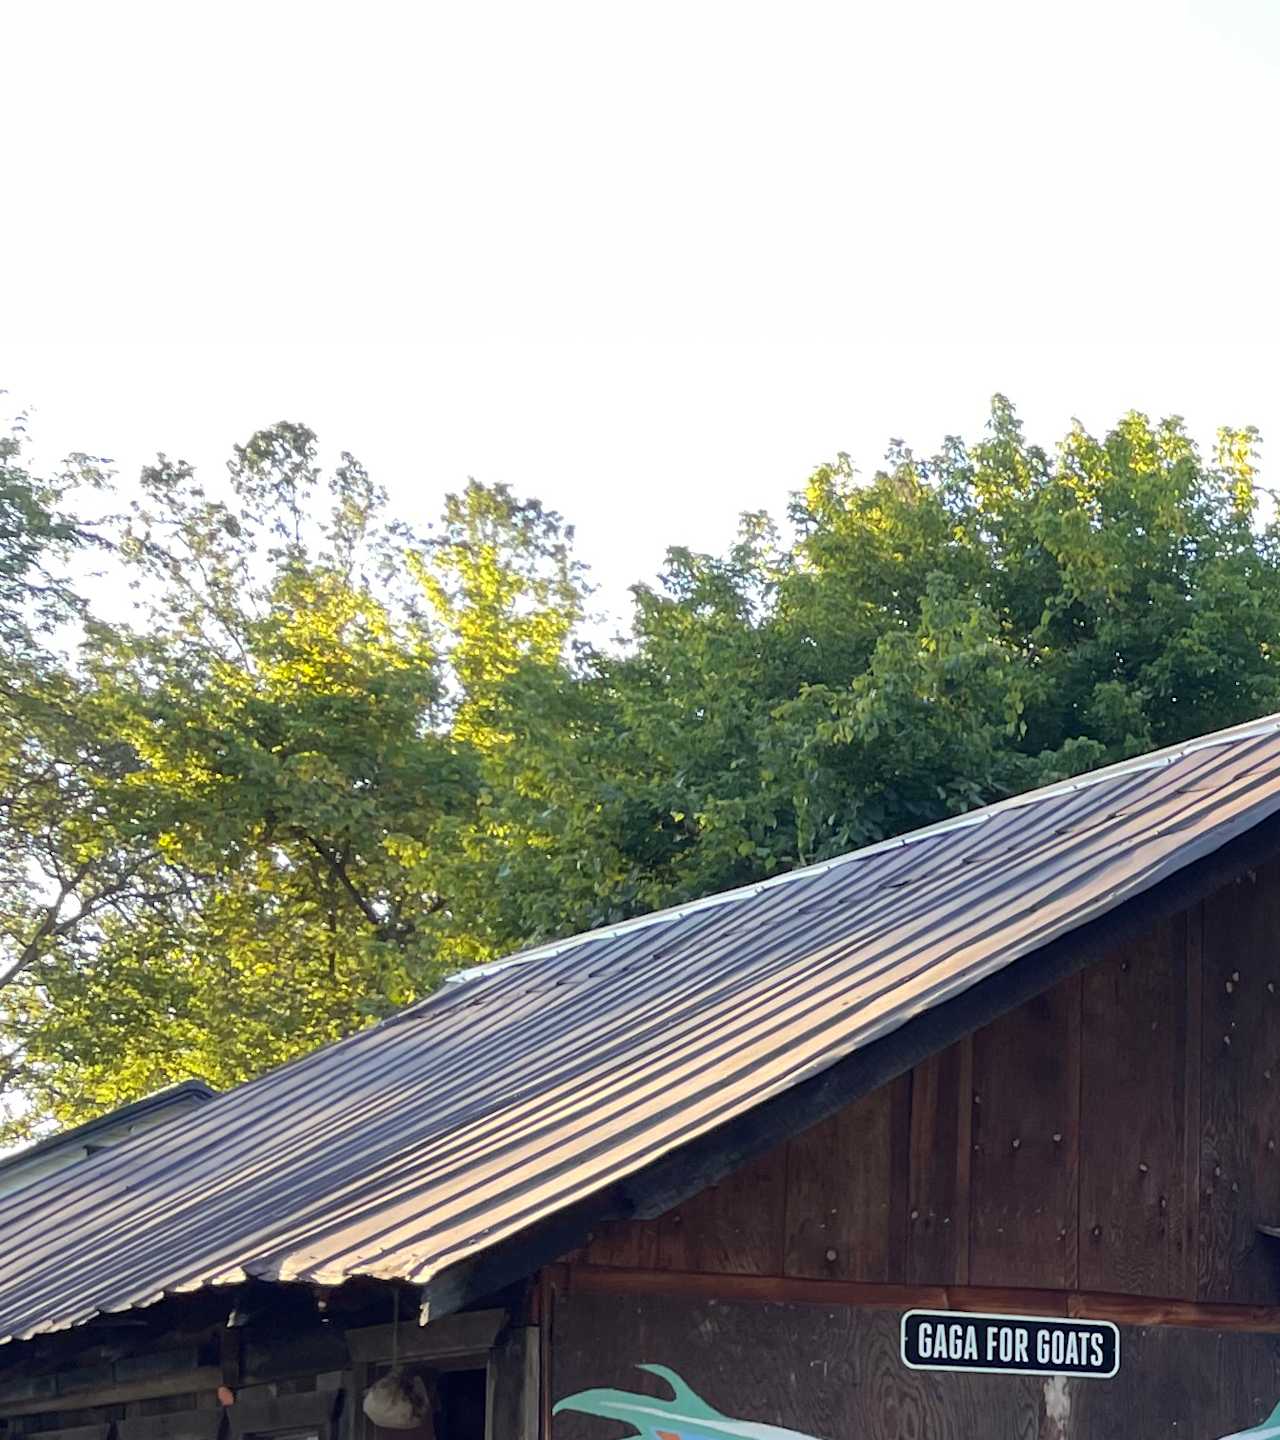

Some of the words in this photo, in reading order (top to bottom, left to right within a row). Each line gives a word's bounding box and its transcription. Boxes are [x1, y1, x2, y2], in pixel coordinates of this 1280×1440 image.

[918, 1322, 978, 1360] GAGA
[986, 1327, 1028, 1362] FOR
[1036, 1329, 1104, 1366] GOATS
